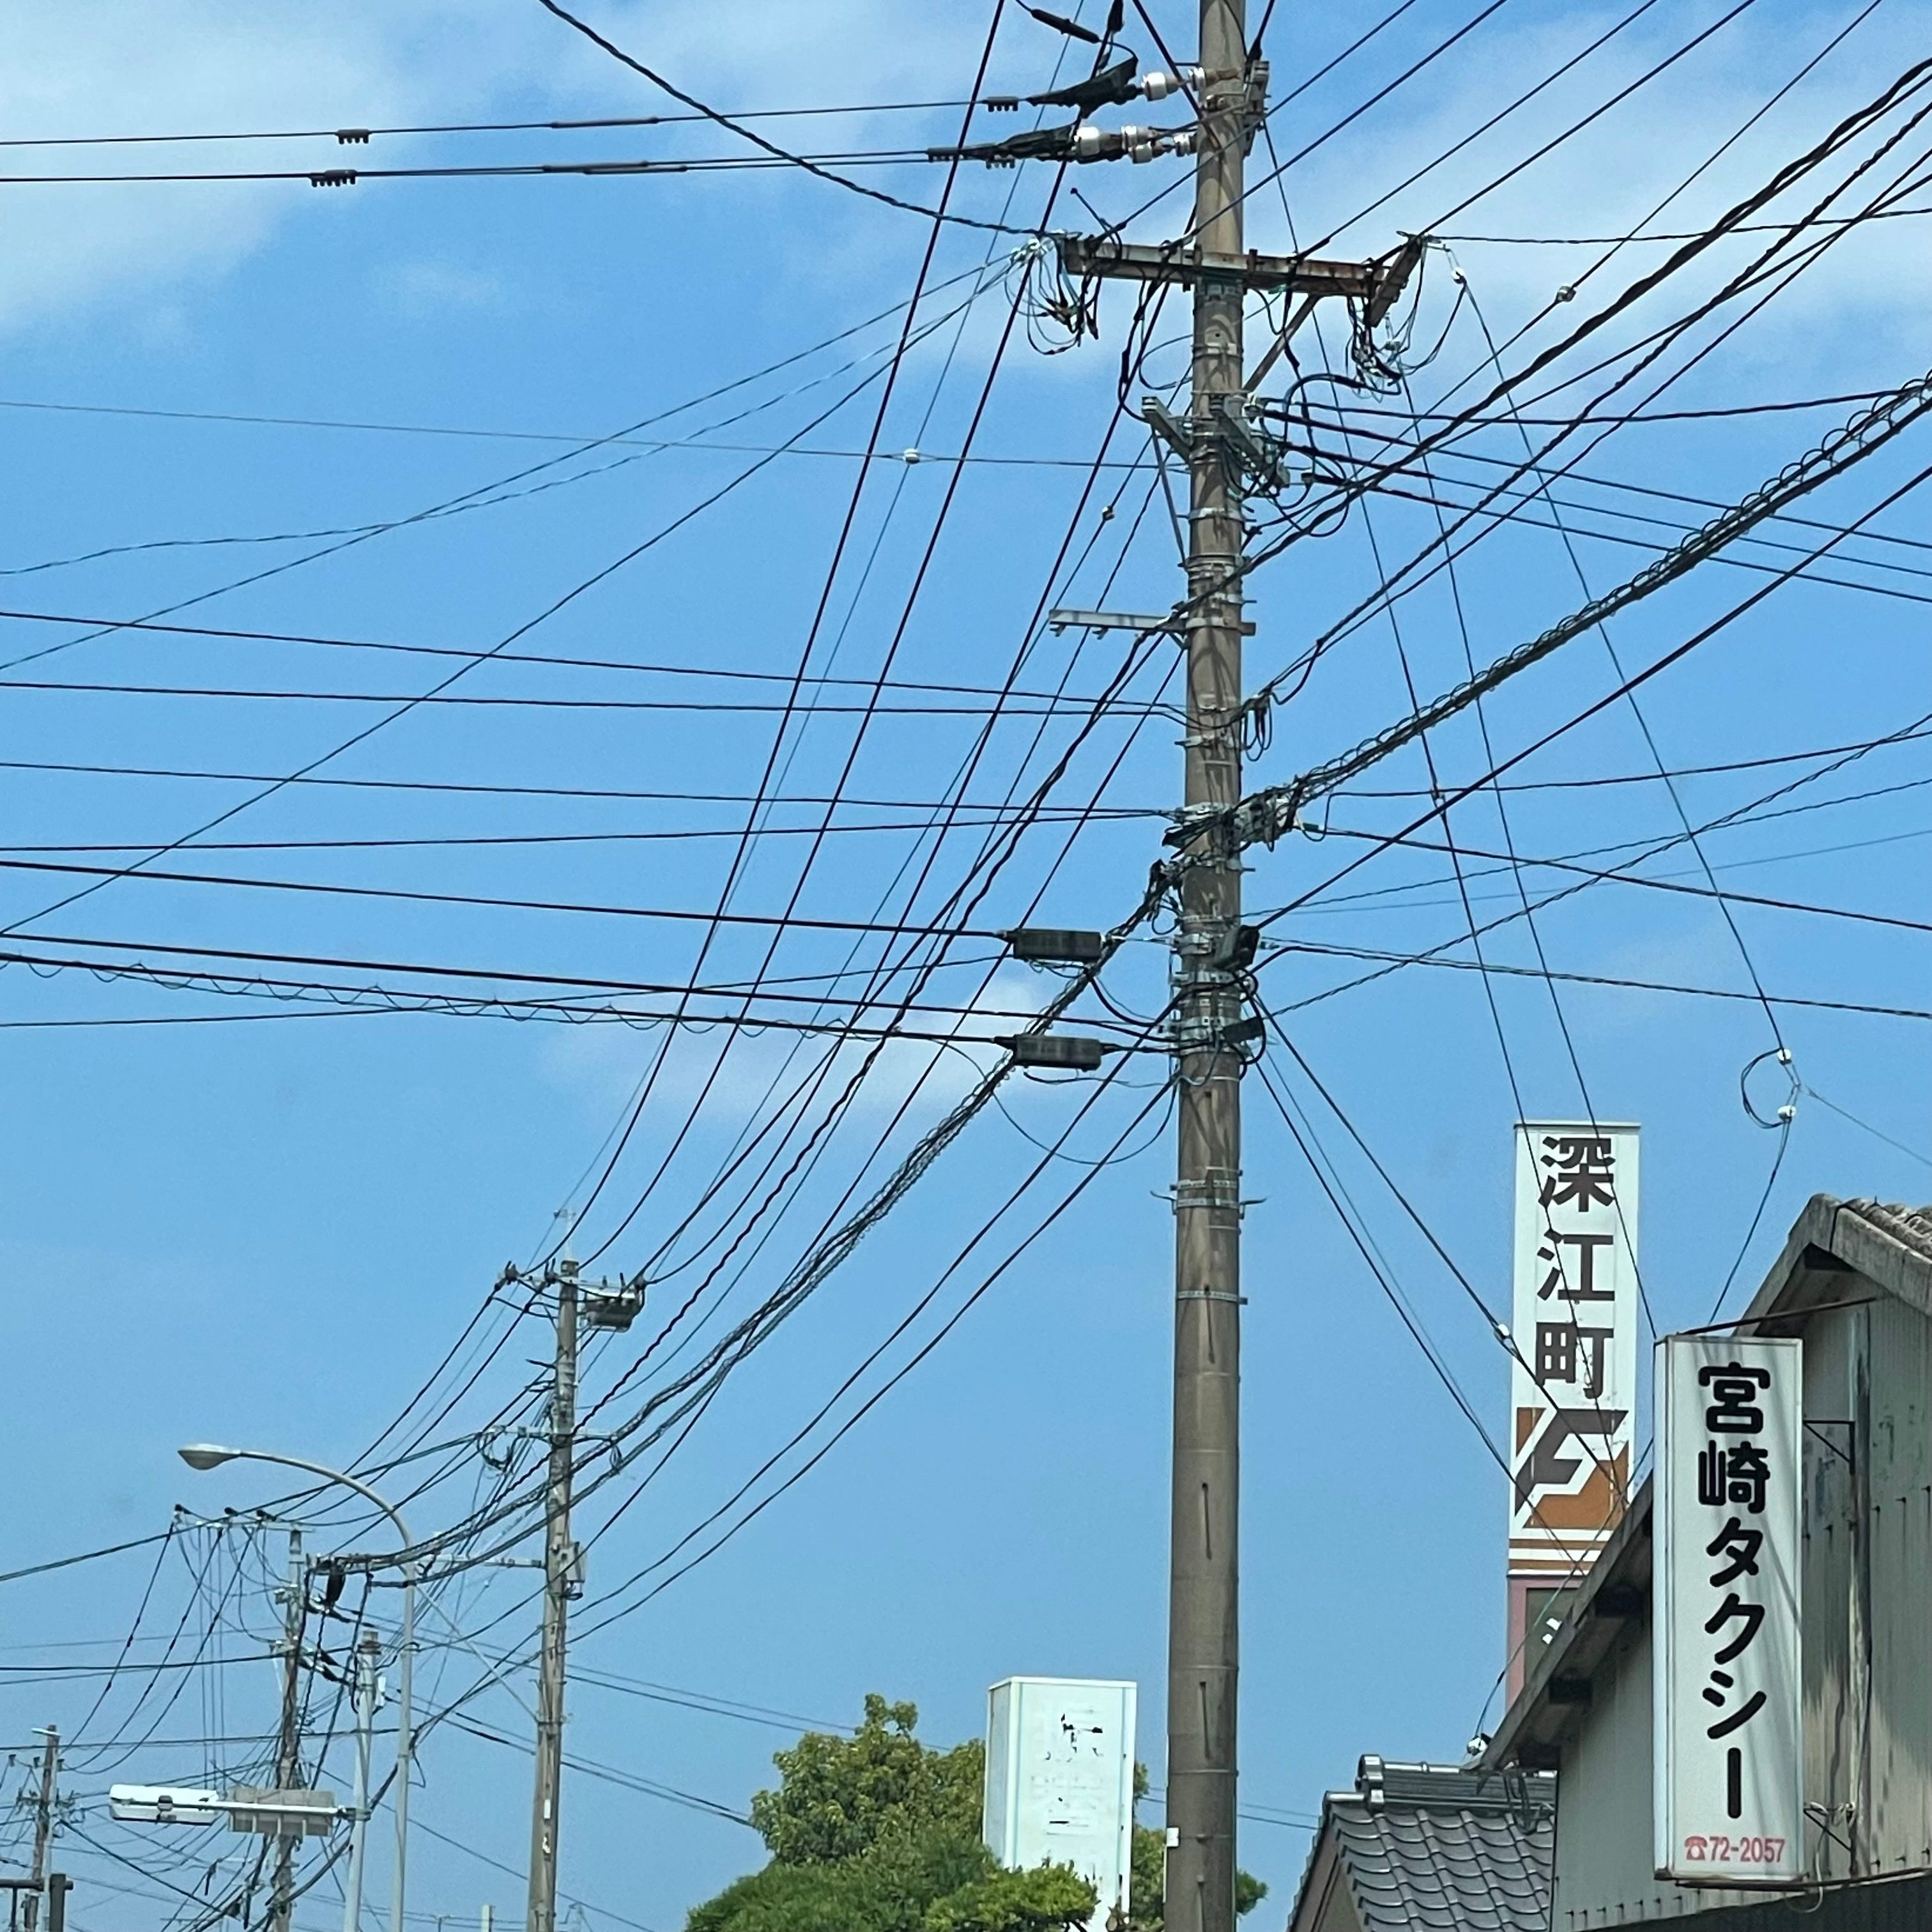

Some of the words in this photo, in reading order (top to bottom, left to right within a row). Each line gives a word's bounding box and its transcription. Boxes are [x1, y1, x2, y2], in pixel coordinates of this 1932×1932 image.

[1537, 1136, 1615, 1399] 深江町
[1698, 1361, 1770, 1820] 宮崎タクシー
[1709, 1836, 1785, 1862] 72-2057
